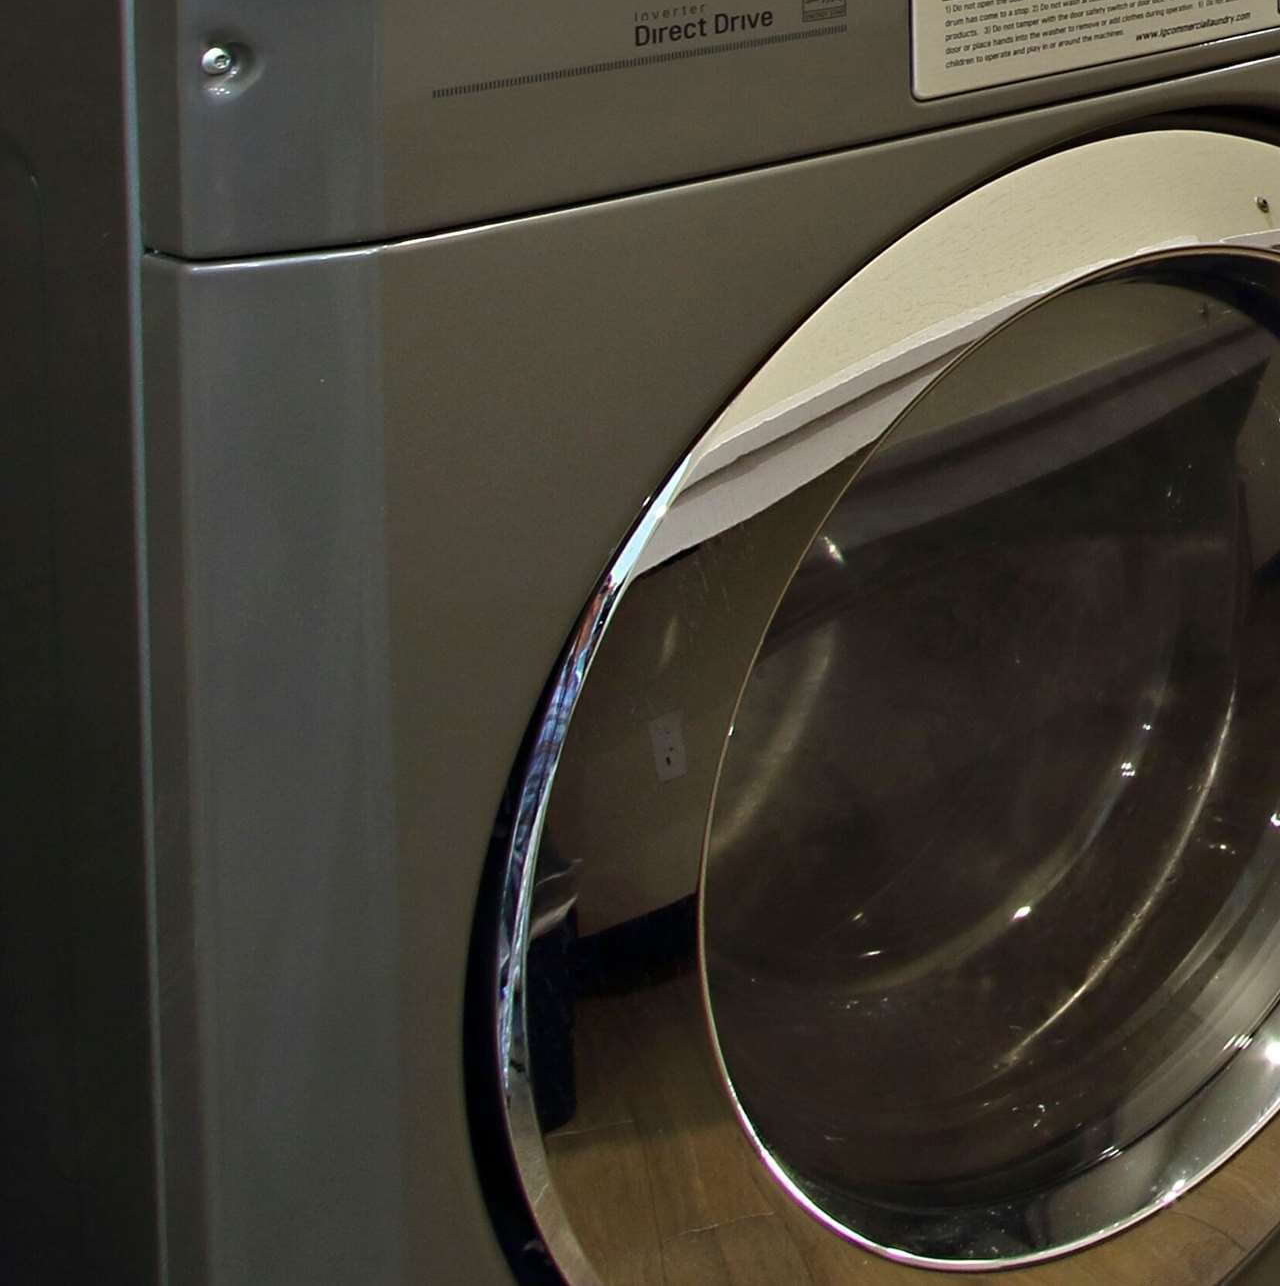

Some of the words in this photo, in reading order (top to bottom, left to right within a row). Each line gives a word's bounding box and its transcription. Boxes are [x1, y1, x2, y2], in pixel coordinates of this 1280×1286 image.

[964, 1, 974, 10] not
[976, 0, 993, 8] open
[635, 17, 707, 47] Direct
[714, 10, 773, 35] Drive
